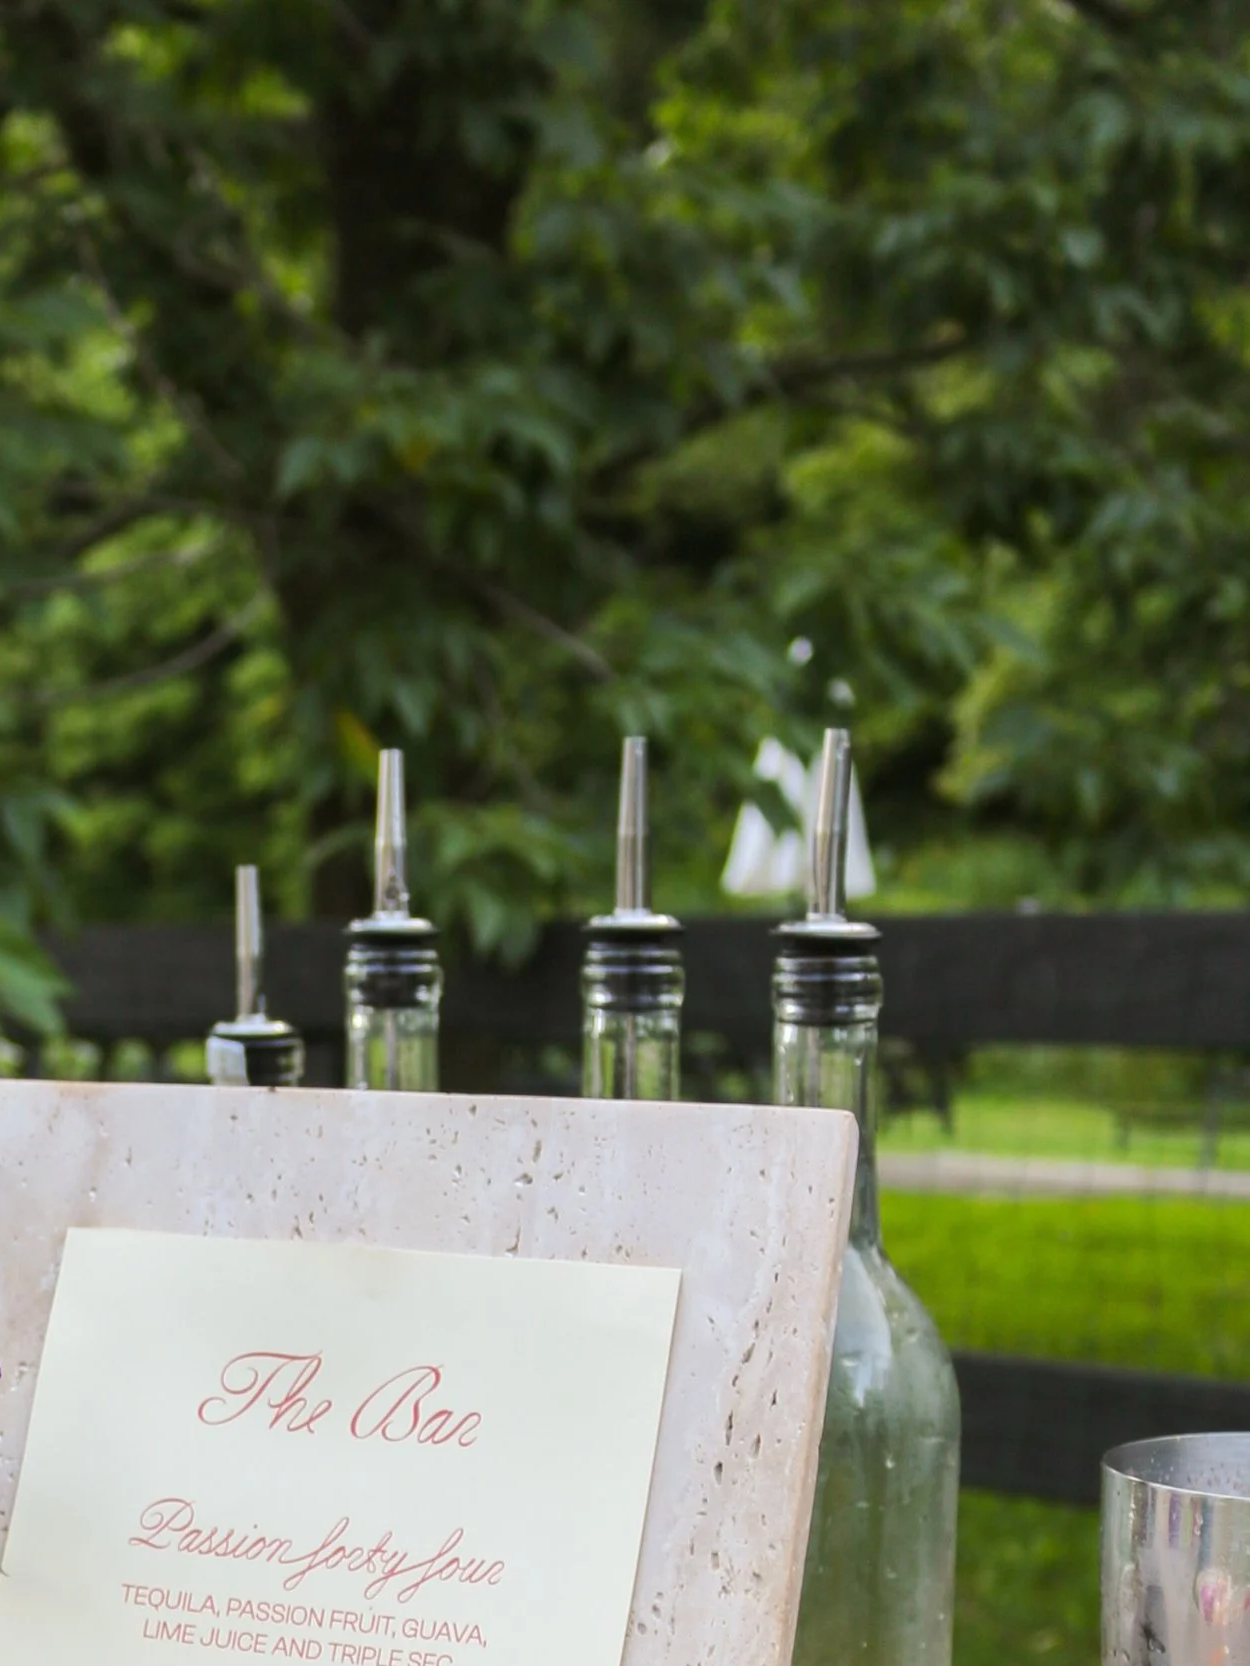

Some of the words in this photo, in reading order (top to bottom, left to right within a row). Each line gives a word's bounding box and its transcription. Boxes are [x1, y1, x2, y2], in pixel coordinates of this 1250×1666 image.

[198, 1350, 333, 1434] The
[350, 1364, 481, 1447] Bar
[128, 1497, 293, 1563] Passion
[284, 1516, 406, 1600] forty
[398, 1527, 505, 1603] four
[121, 1583, 221, 1618] TEQUILA,
[226, 1597, 325, 1629] PASSION
[329, 1610, 397, 1638] FRUIT,
[401, 1617, 488, 1648] GUAVA,
[142, 1618, 196, 1645] LIME
[200, 1628, 268, 1654] JUICE
[272, 1636, 322, 1660] AND
